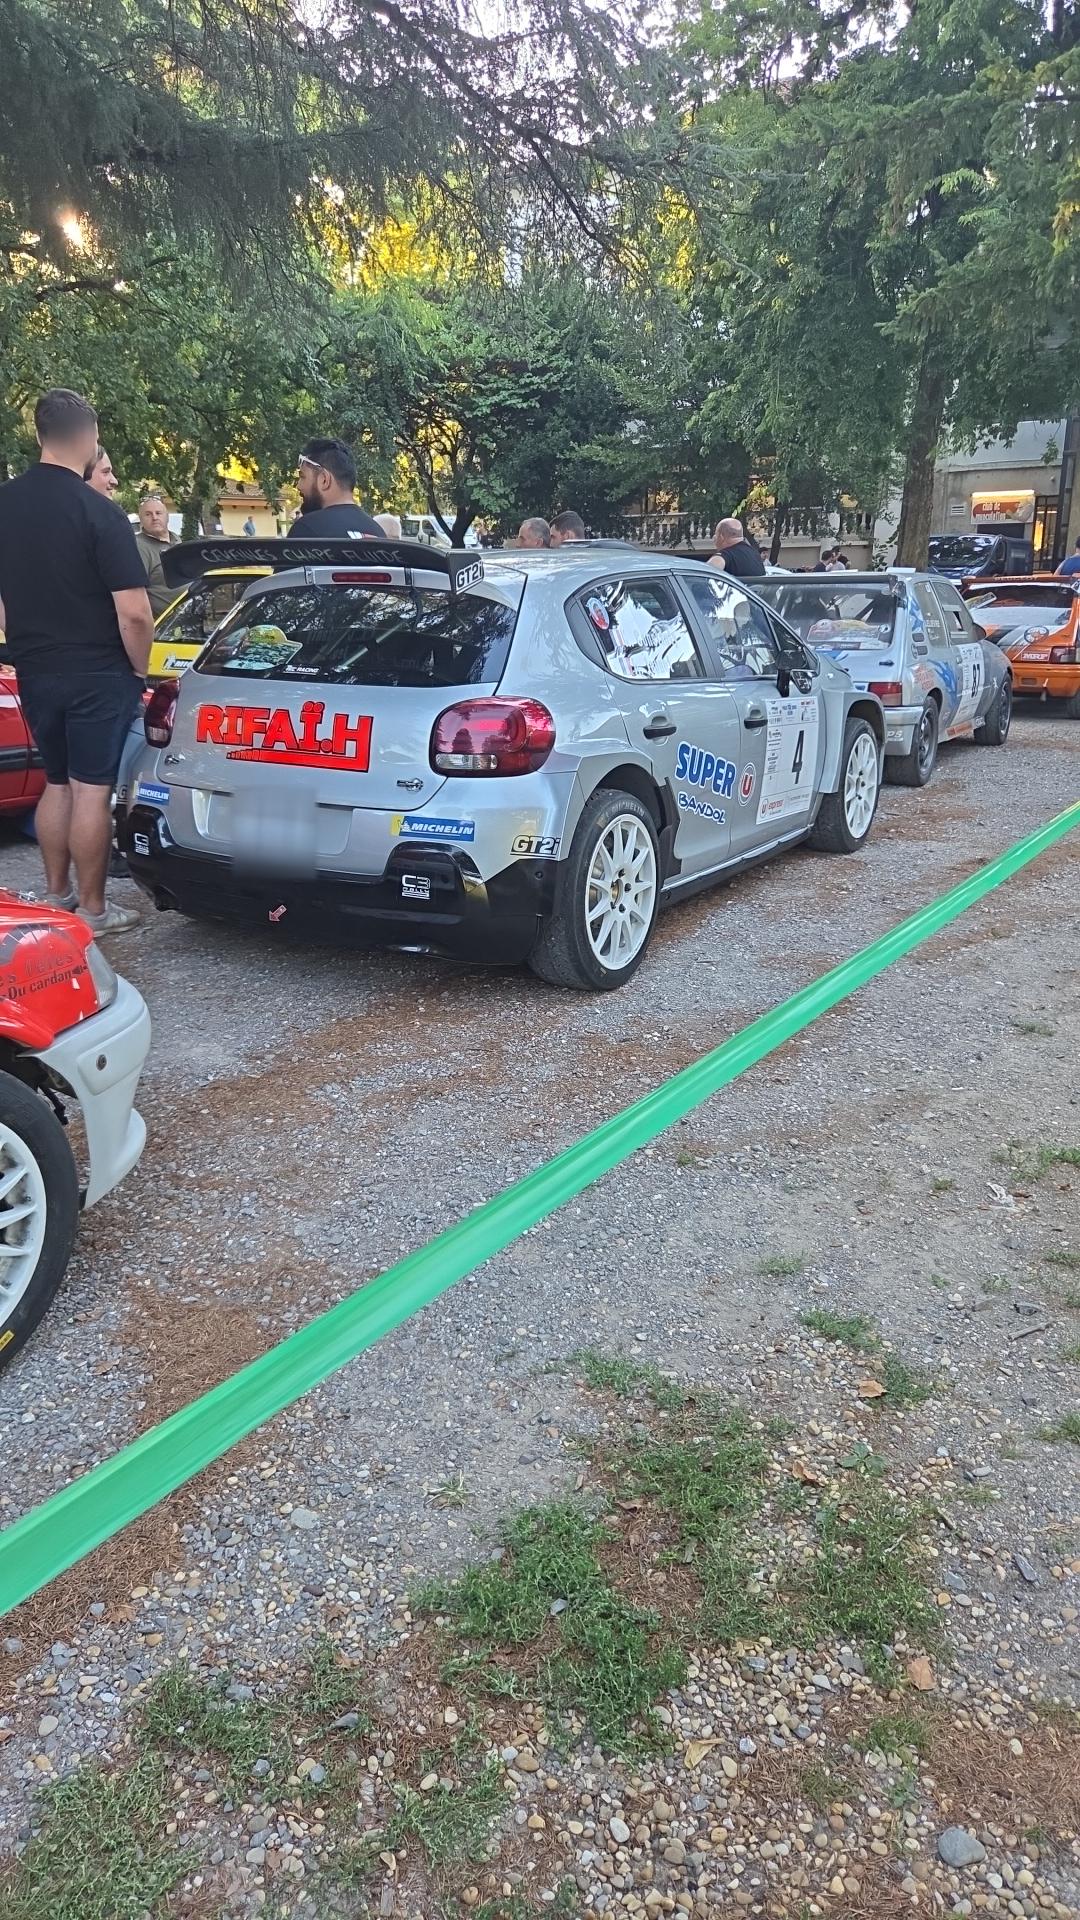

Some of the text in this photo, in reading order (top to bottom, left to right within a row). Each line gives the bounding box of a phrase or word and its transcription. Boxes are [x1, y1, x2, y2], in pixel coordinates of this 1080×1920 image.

[791, 730, 804, 785] 4
[675, 742, 736, 798] SUPER
[741, 773, 754, 797] U
[139, 788, 170, 800] MICHELIN
[678, 792, 725, 824] BANDOL
[411, 822, 475, 835] MICHELIN
[512, 835, 562, 856] GT2i
[402, 874, 431, 890] C3
[30, 970, 72, 992] cardan
